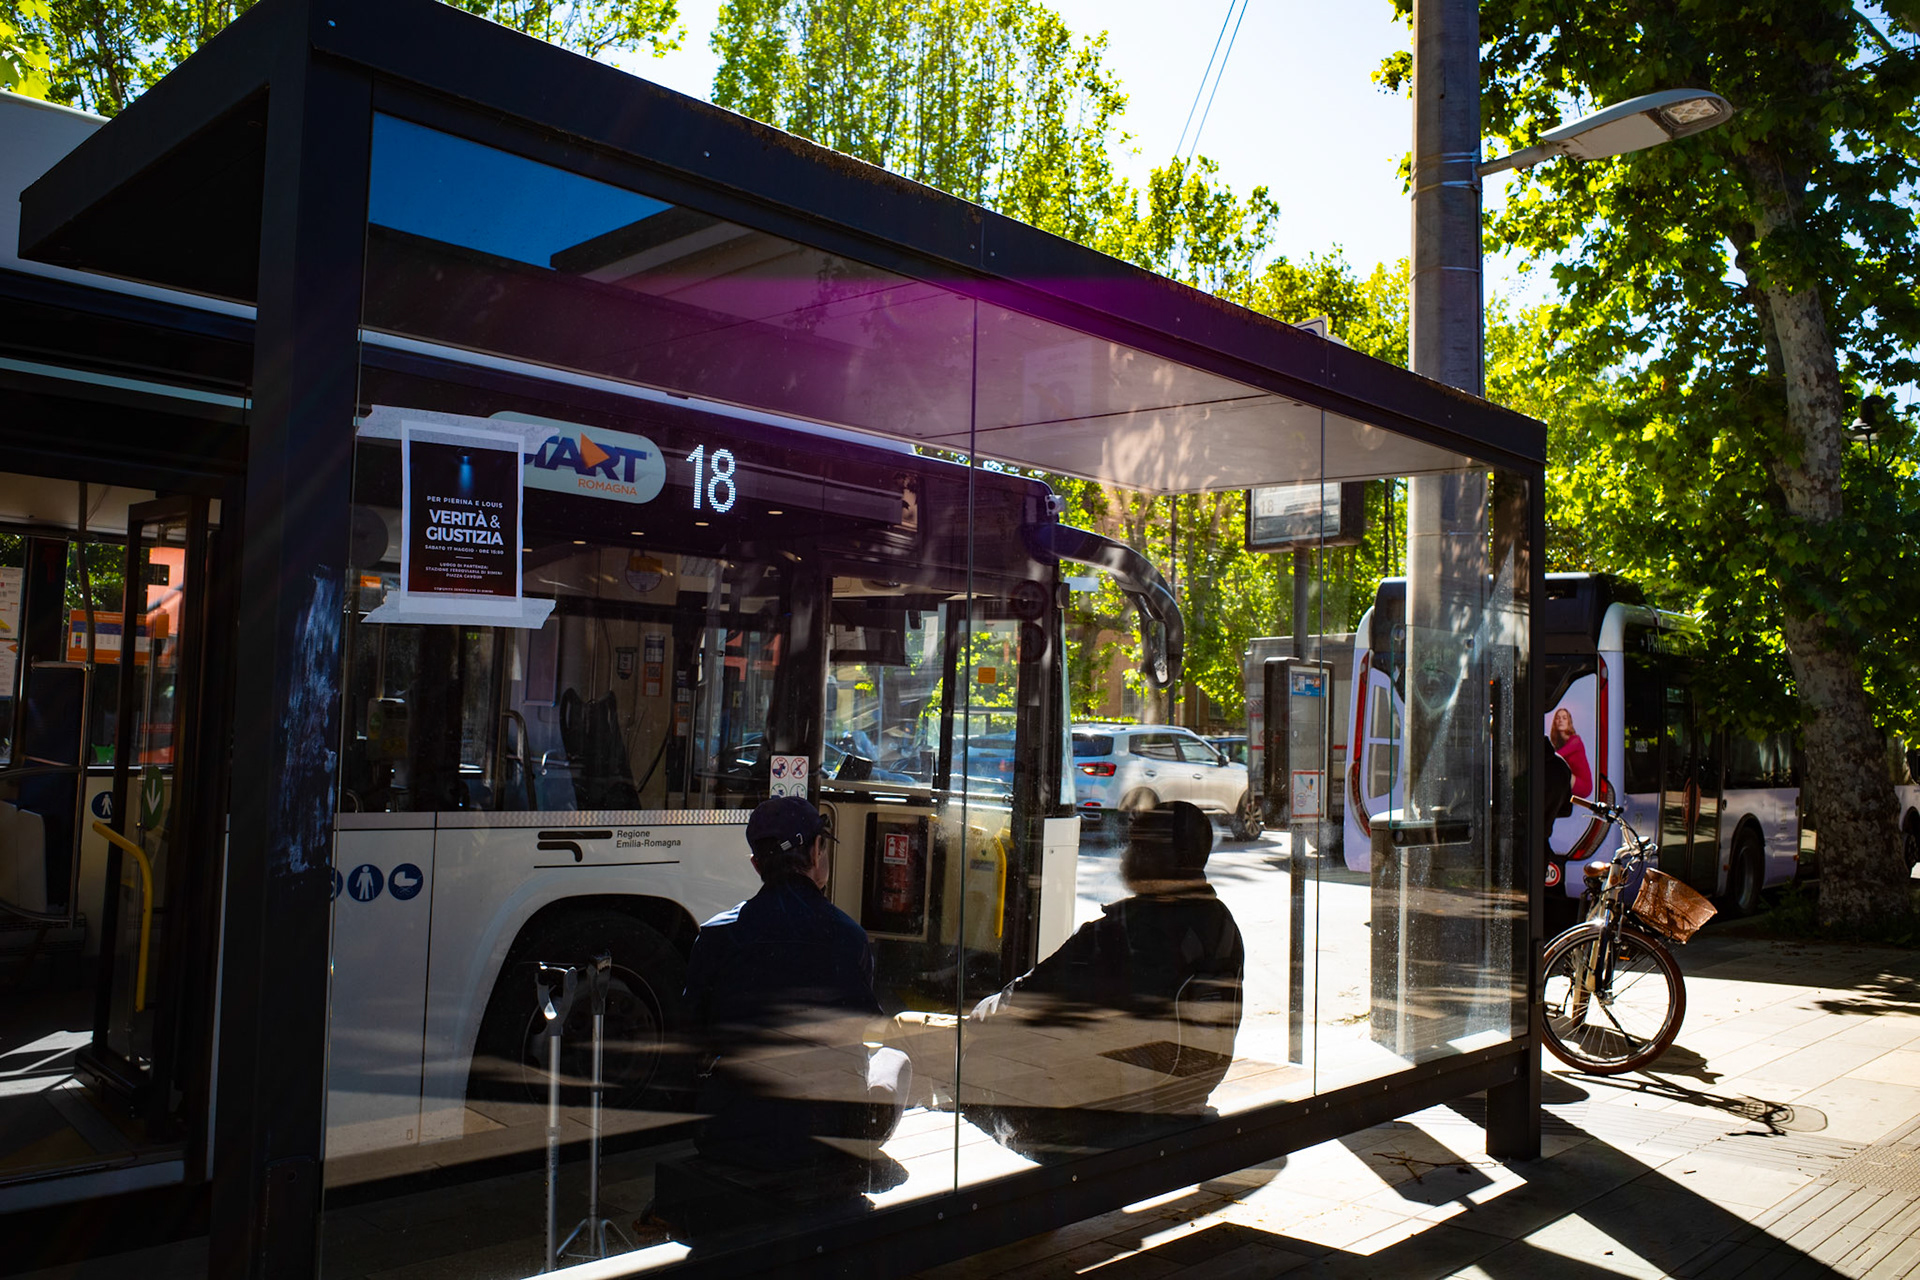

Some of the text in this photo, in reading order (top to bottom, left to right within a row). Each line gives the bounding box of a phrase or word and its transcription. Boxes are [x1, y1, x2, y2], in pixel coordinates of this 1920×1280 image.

[578, 478, 638, 496] ROMAGNA
[686, 444, 736, 513] 18
[444, 498, 473, 506] PIERINA
[429, 509, 500, 528] VERITÀ &
[426, 526, 504, 545] GIUSTIZIA
[616, 830, 650, 840] Regione
[616, 839, 681, 849] Emilia-Romagna
